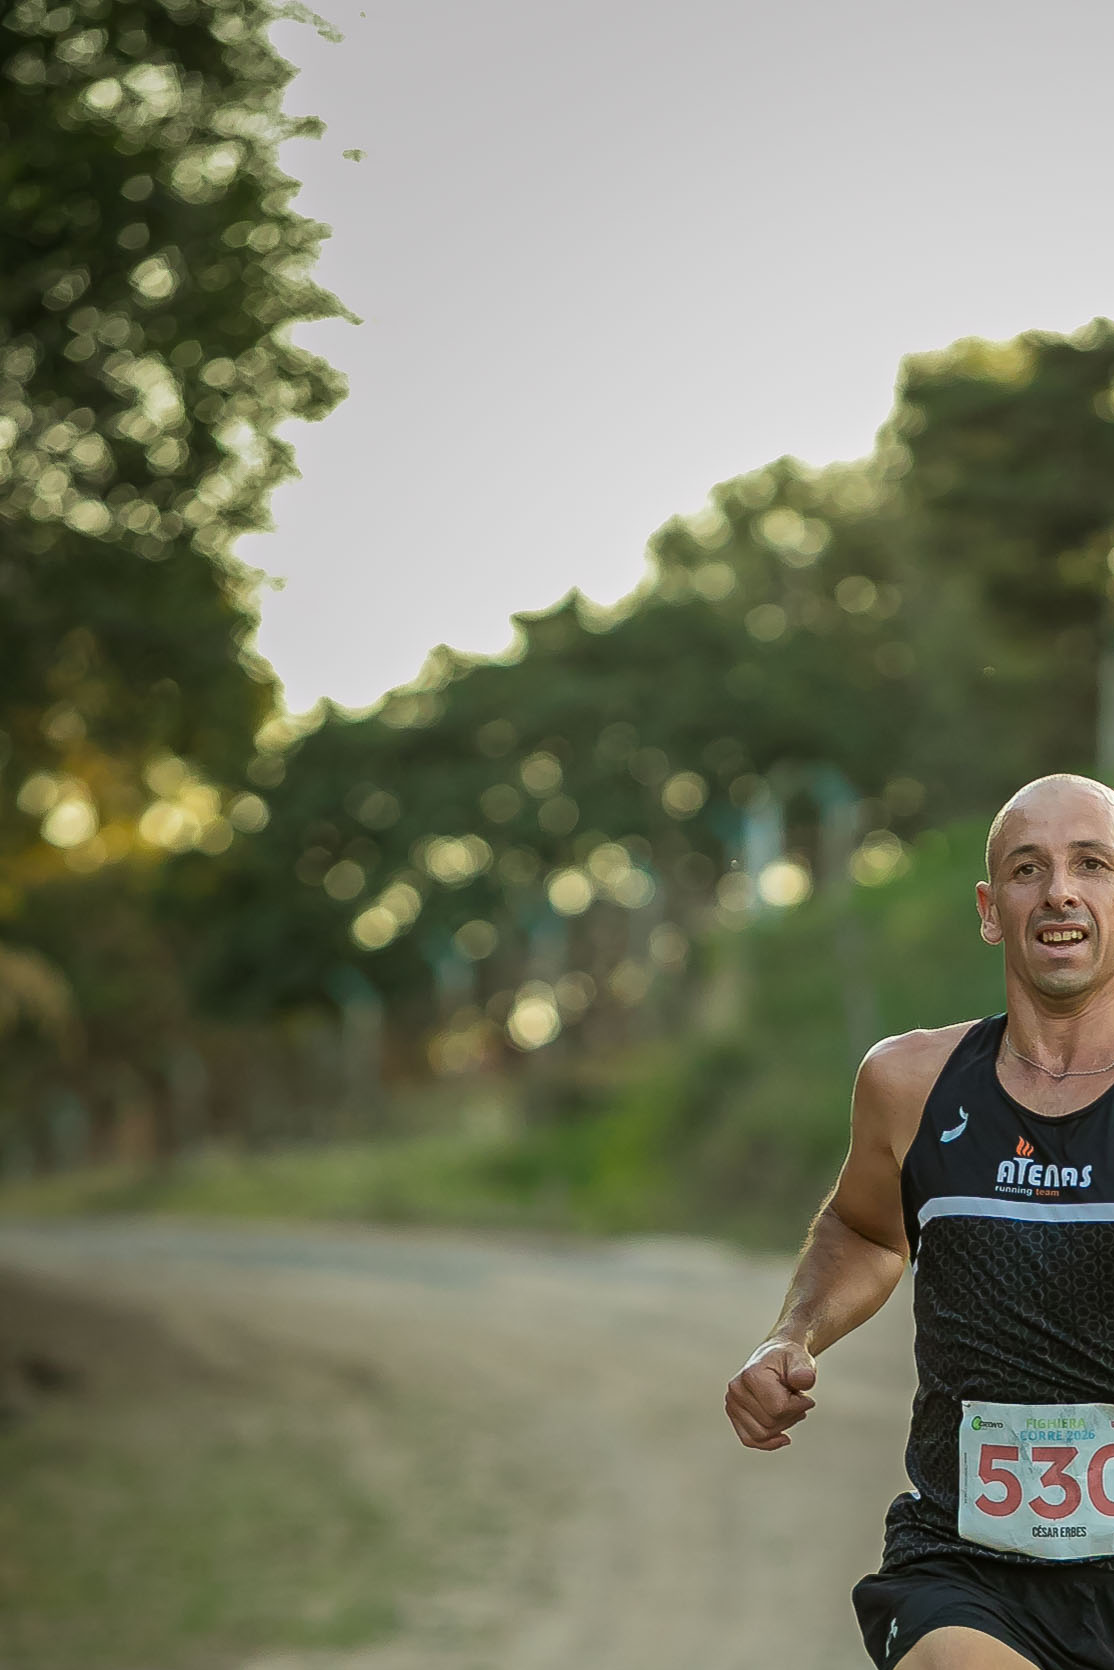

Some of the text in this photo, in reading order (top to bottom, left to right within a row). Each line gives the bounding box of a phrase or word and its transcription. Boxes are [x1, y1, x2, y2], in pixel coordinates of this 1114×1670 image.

[996, 1157, 1093, 1188] ATENAS
[994, 1185, 1060, 1197] running team
[1026, 1417, 1086, 1429] FIGHIERA
[1020, 1430, 1062, 1441] CORRE
[1032, 1524, 1087, 1538] CÉSAR ERBES
